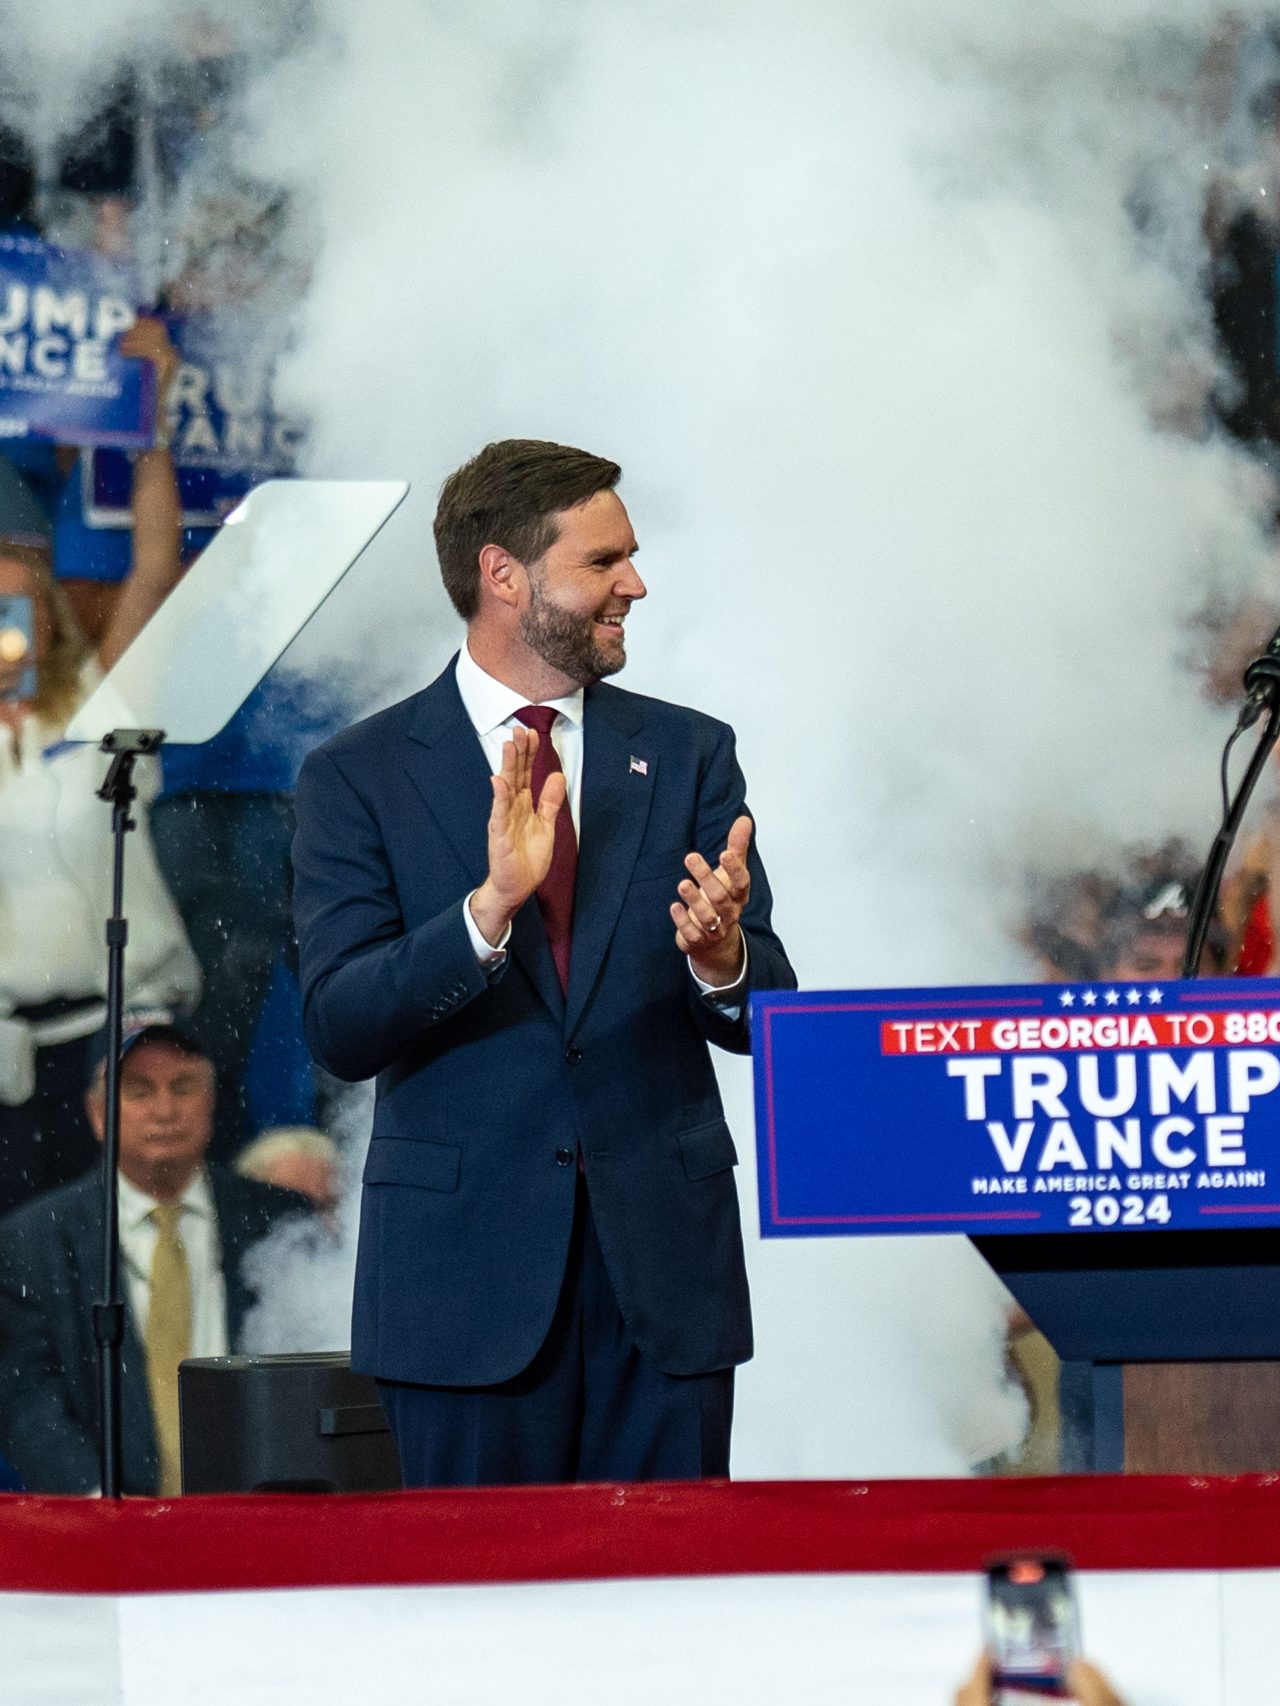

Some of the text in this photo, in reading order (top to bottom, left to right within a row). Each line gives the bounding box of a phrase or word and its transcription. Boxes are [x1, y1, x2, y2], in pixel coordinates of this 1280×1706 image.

[892, 1021, 981, 1053] TEXT
[991, 1016, 1158, 1050] GEORGIA
[1165, 1013, 1215, 1045] TO
[986, 1115, 1247, 1172] VANCE
[971, 1169, 1266, 1194] MAKE AMERICA GREAT AGAIN!
[1068, 1195, 1172, 1227] 2024
